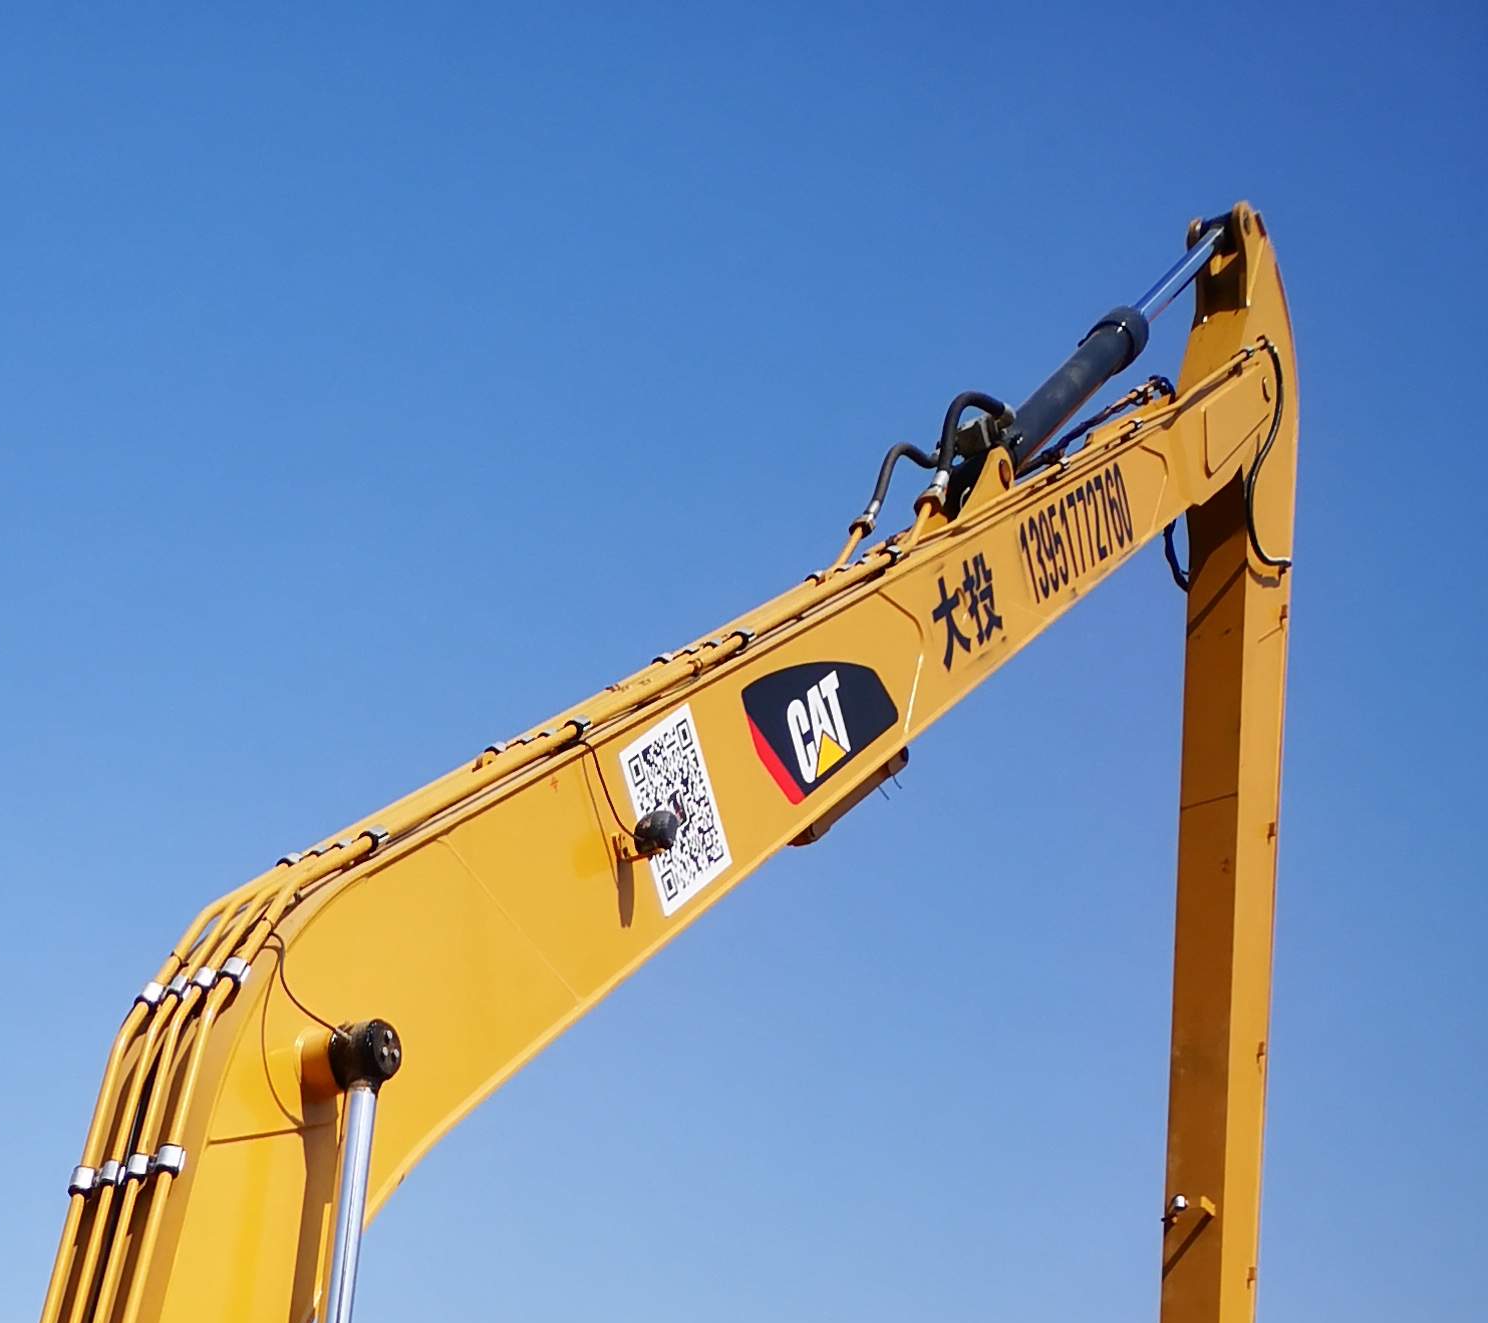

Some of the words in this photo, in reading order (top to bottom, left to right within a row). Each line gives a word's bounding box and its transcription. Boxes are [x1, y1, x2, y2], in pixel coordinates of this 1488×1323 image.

[932, 552, 1003, 673] 大投
[1019, 462, 1134, 605] 13951772760
[787, 670, 852, 784] CAT
